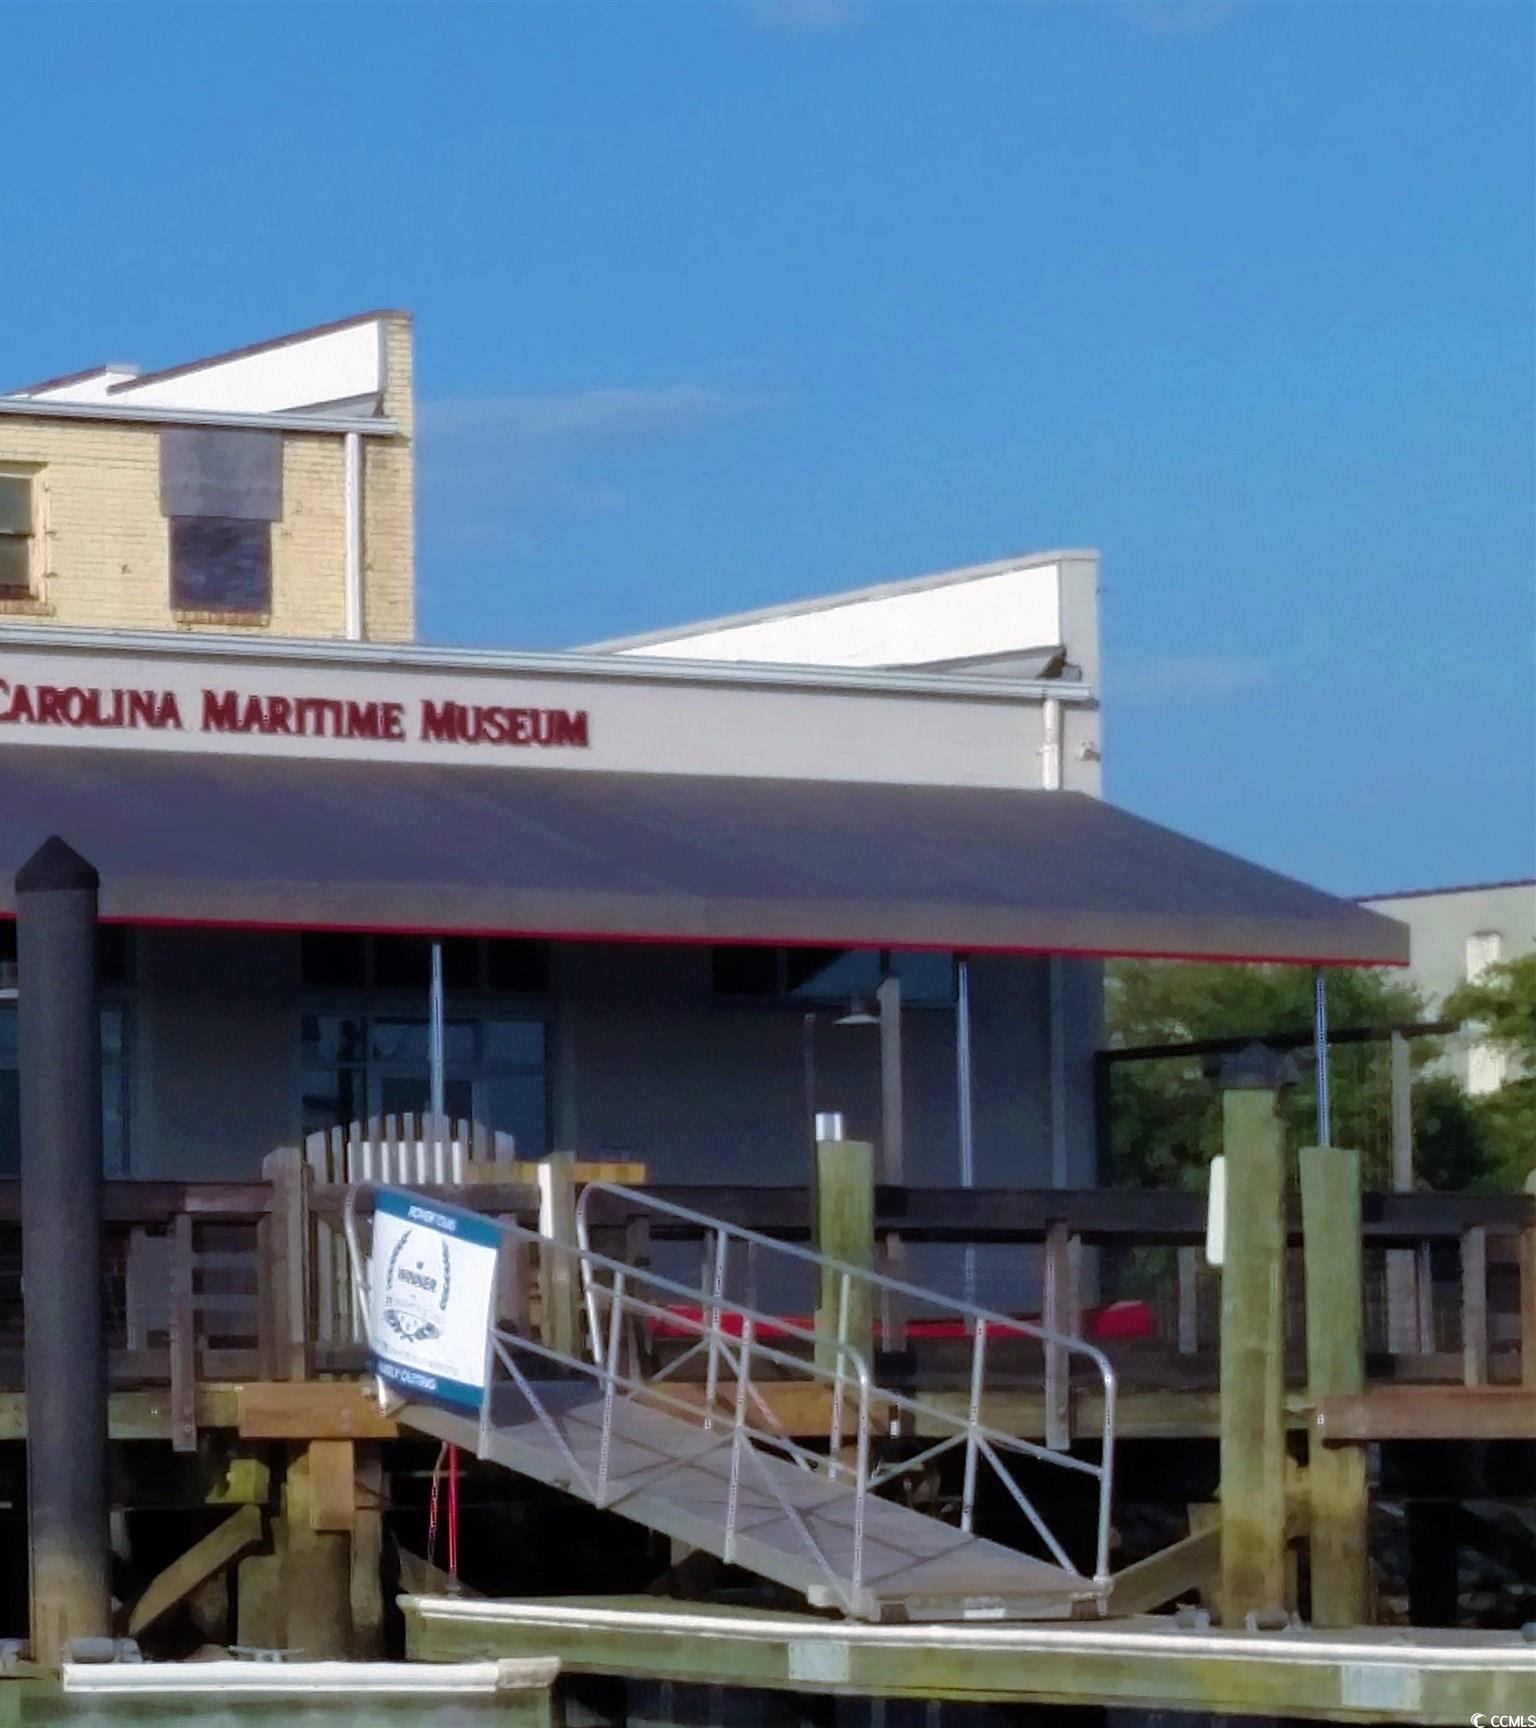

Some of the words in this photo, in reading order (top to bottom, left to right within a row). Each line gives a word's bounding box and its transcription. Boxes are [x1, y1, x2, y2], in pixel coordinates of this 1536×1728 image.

[202, 690, 406, 741] MARITIME
[421, 700, 589, 748] MUSEUM
[398, 1268, 437, 1292] WINNER
